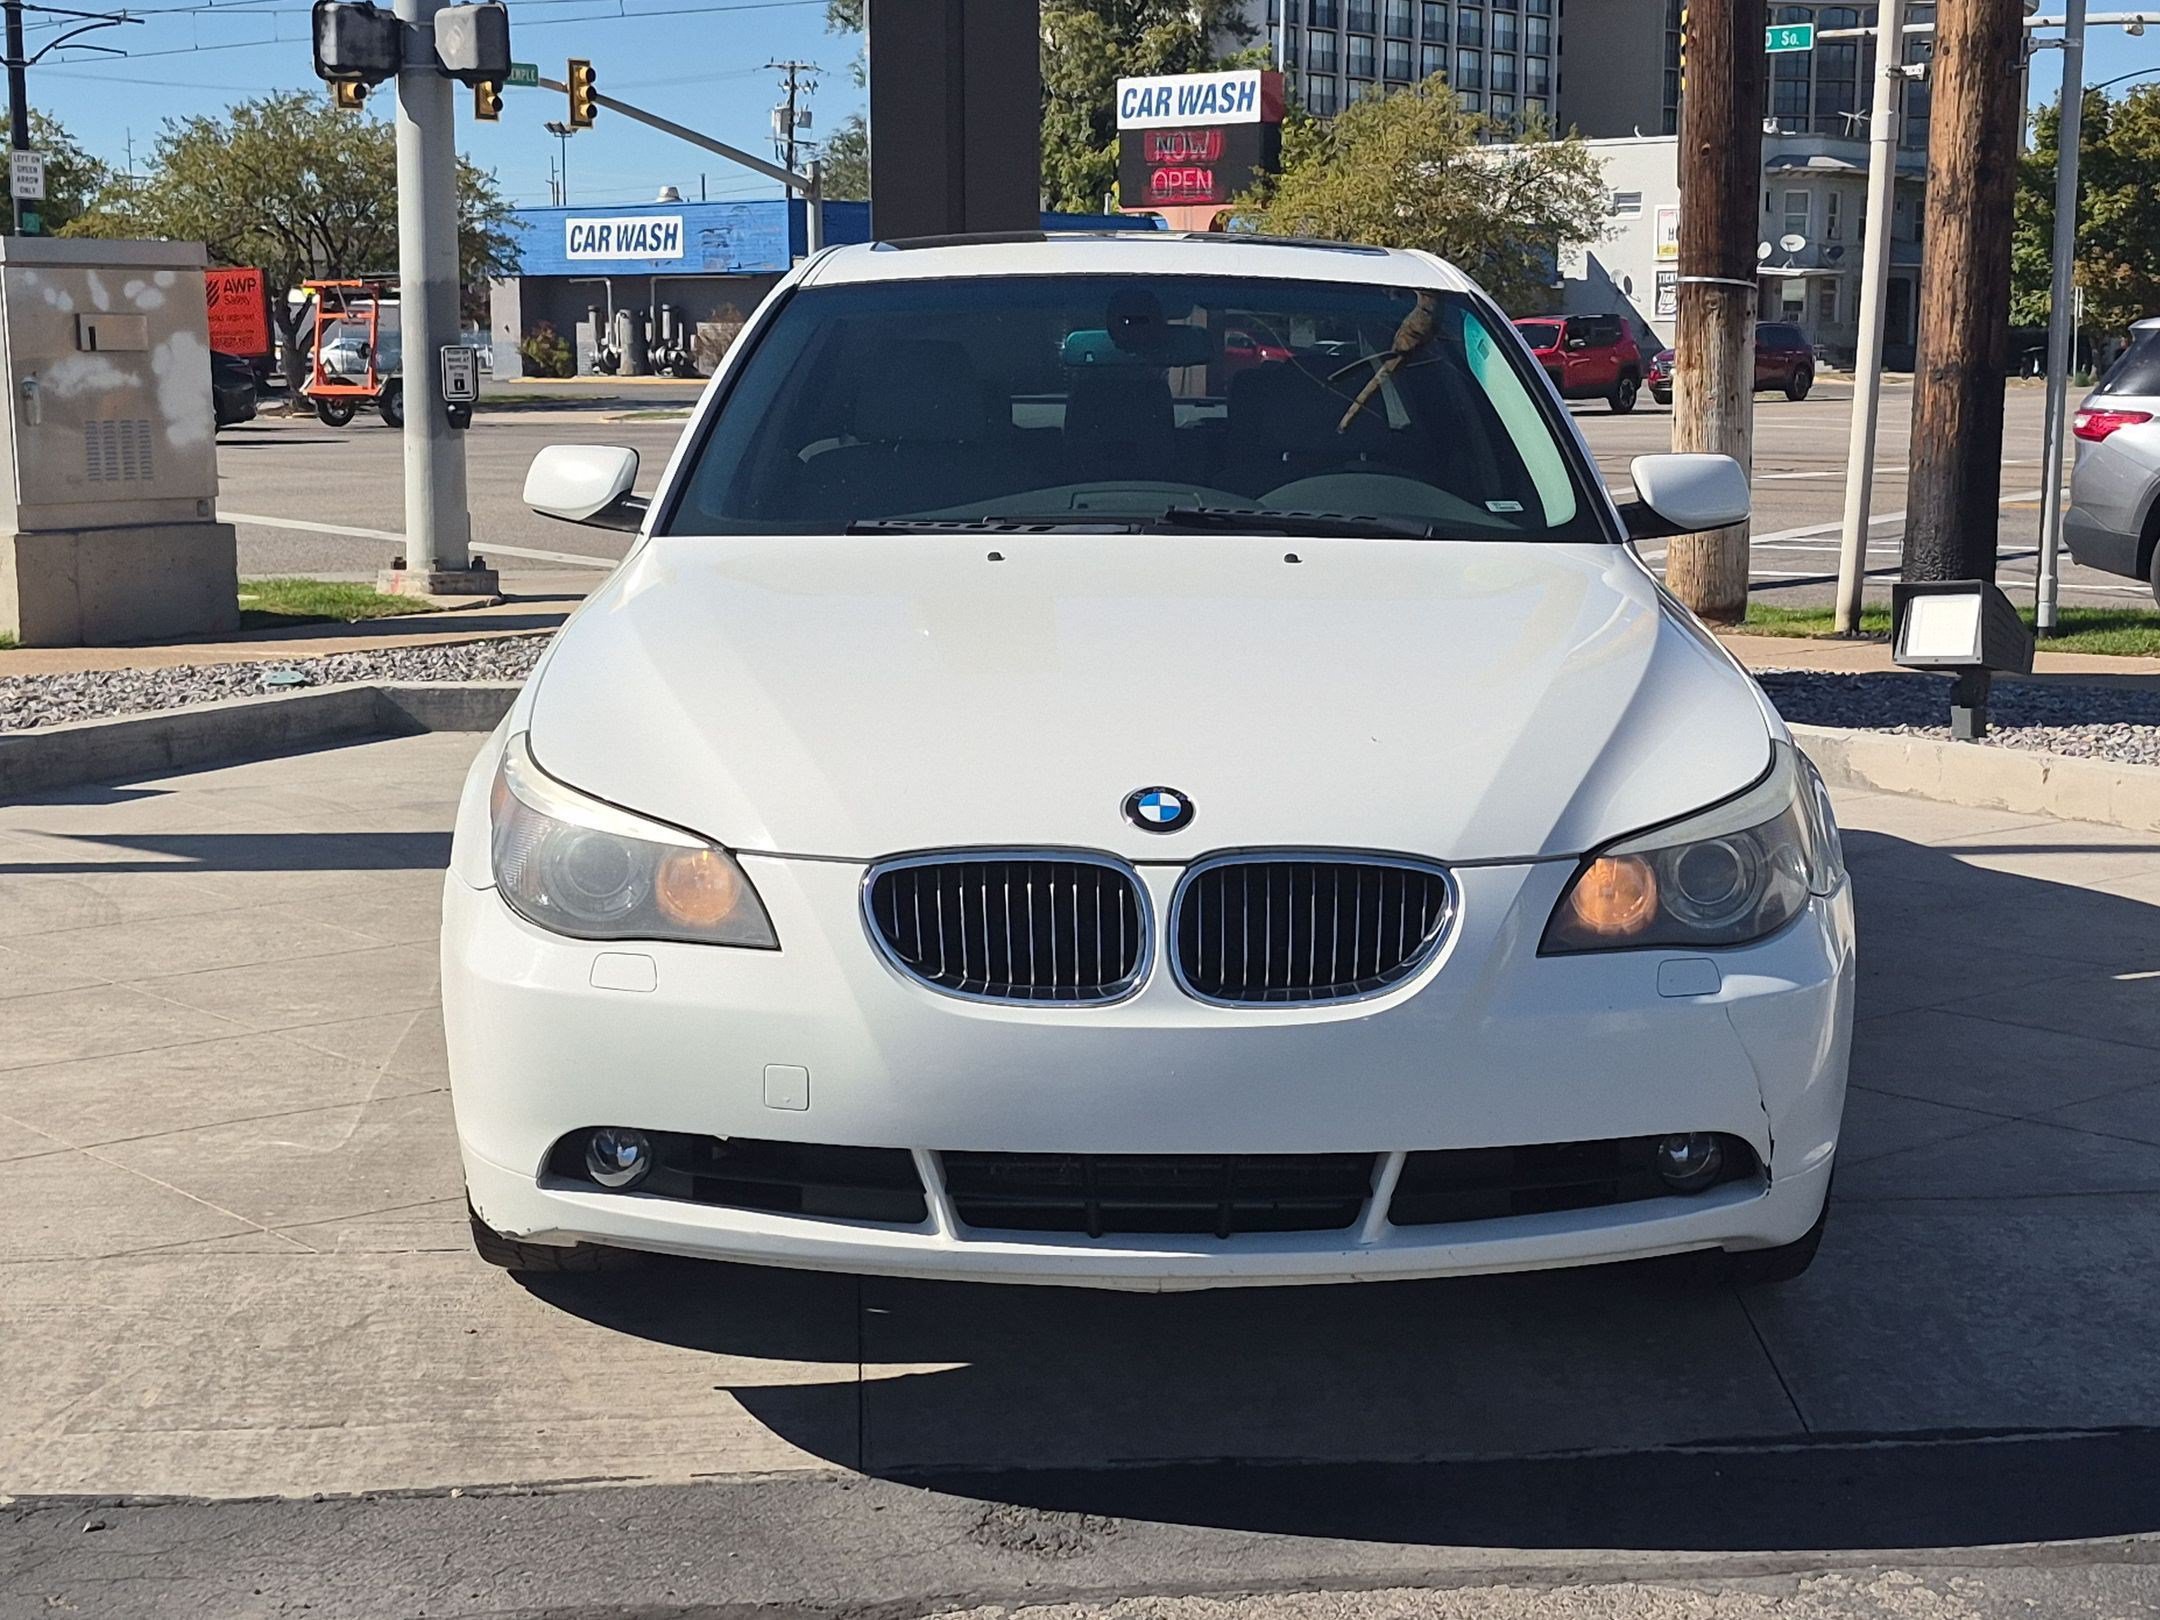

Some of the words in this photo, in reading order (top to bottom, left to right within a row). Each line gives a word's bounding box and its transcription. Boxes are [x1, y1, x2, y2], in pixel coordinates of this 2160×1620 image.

[1781, 31, 1799, 46] So.
[508, 68, 537, 82] EMPLE
[1121, 86, 1172, 119] CAR
[1178, 80, 1256, 116] WASH
[1155, 130, 1211, 160] NOW
[1152, 168, 1213, 199] OPEN
[570, 224, 611, 253] CAR
[616, 222, 678, 252] WASH
[223, 277, 256, 294] AWP
